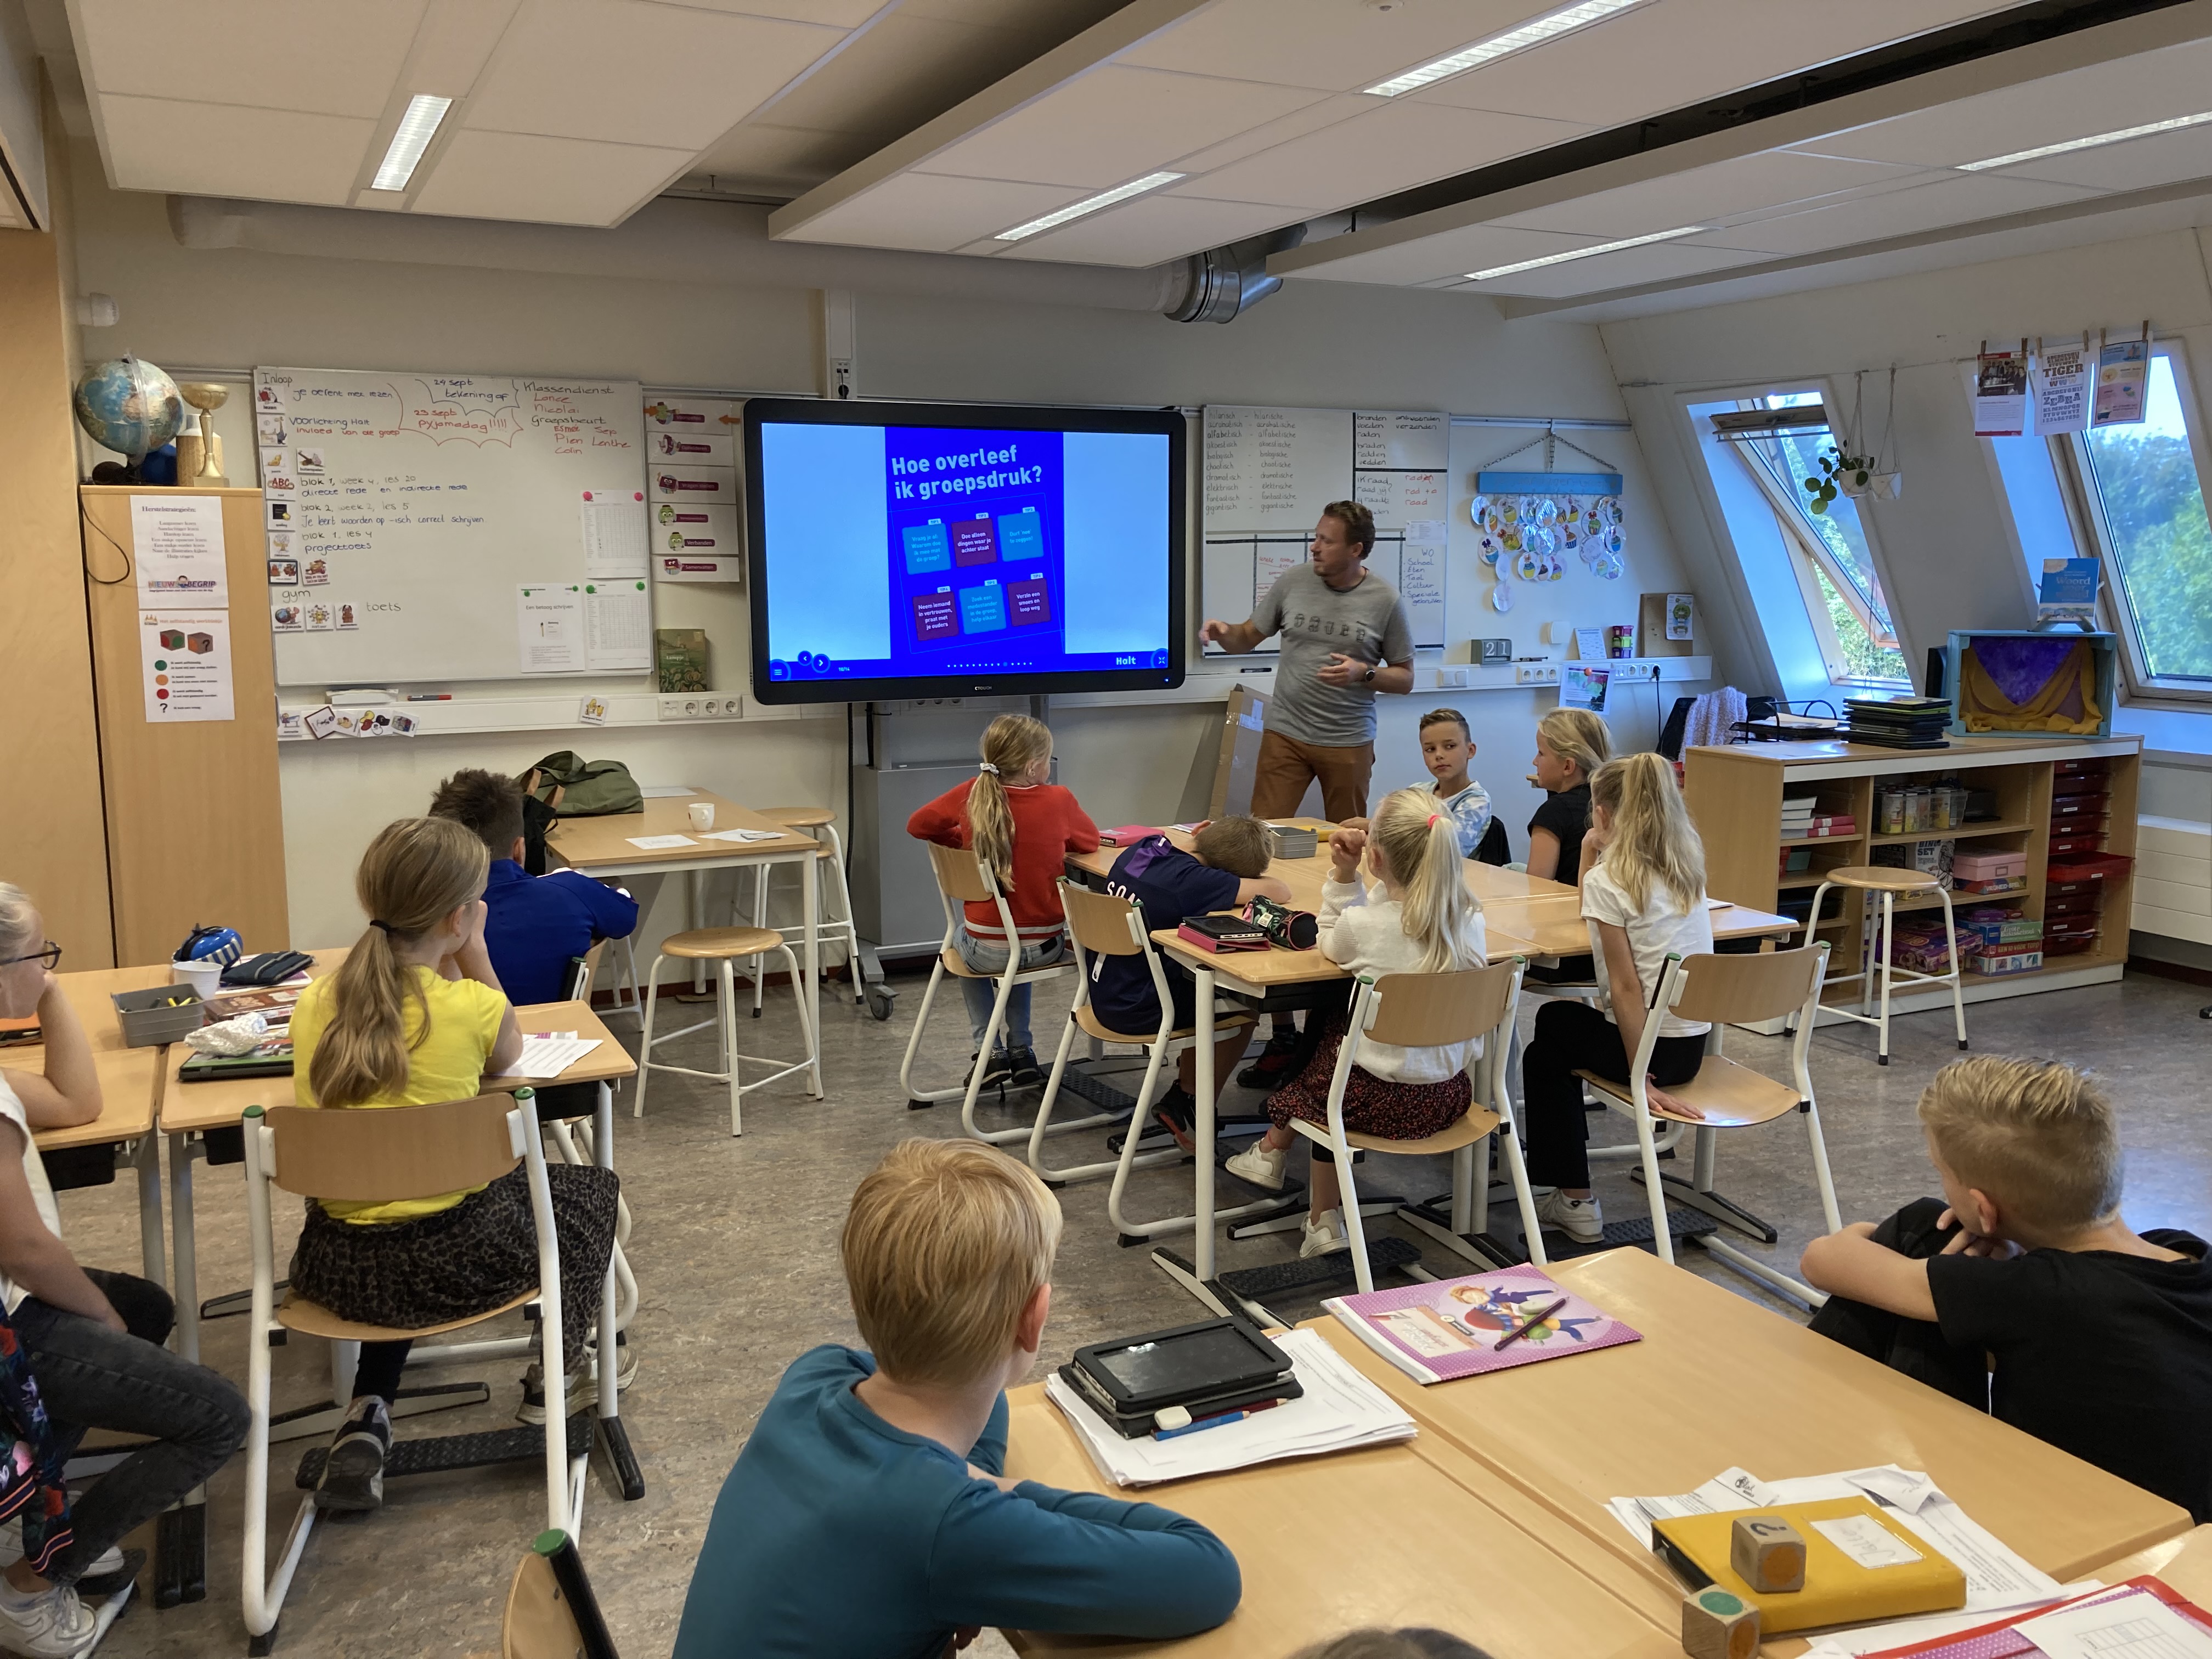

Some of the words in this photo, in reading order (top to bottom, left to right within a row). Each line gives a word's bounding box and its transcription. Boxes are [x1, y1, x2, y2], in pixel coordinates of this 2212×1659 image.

[2042, 363, 2084, 378] TIGER
[263, 372, 293, 384] Inloop
[448, 379, 474, 387] sept
[523, 381, 616, 394] Klassendienst
[311, 389, 343, 398] oefent
[369, 391, 393, 399] lezen
[445, 389, 492, 403] tekening
[534, 393, 573, 404] Lance
[2042, 392, 2081, 407] ZEBRA
[431, 408, 458, 419] sept
[1209, 411, 1236, 420] hilarisch
[1254, 411, 1284, 420] hilarische
[289, 416, 348, 430] Voorlichting
[351, 417, 370, 426] Halt
[379, 429, 400, 438] groep
[594, 426, 617, 437] Sep
[1207, 429, 1243, 439] alfabetisch
[1258, 428, 1296, 438] alfabetische
[555, 433, 584, 445] Pien
[592, 437, 632, 449] Lenthe
[1207, 439, 1238, 449] akoestisch
[1259, 440, 1292, 448] akoestische
[555, 447, 583, 455] Colin
[1207, 450, 1234, 463] biologisch
[1260, 450, 1288, 460] biologische
[891, 456, 930, 476] Hoe
[935, 444, 1017, 471] overleef
[1206, 461, 1234, 471] chaotisch
[272, 477, 290, 487] ABC
[300, 476, 325, 487] blok
[339, 476, 368, 484] week
[385, 476, 399, 484] les
[1206, 472, 1242, 481] dramatisch
[894, 481, 915, 499] ik
[919, 465, 1042, 500] groepsdruk?
[1206, 483, 1239, 492] elektrisch
[1262, 482, 1293, 490] elektrische
[302, 487, 340, 497] directe
[399, 484, 442, 493] indirecte
[1206, 494, 1240, 503] fantastisch
[1261, 492, 1297, 500] fantastische
[300, 503, 322, 512] blok
[337, 503, 364, 511] week
[382, 500, 397, 511] les
[402, 502, 410, 510] 5
[1206, 503, 1238, 516] gigantisch
[1261, 501, 1294, 514] gigantische
[301, 516, 314, 527] Je
[318, 515, 336, 526] leert
[341, 516, 374, 526] woorden
[375, 517, 385, 527] op
[418, 514, 445, 524] correct
[302, 530, 325, 540] blok
[346, 530, 362, 538] les
[304, 541, 373, 556] projecttoets
[1421, 548, 1435, 557] WO
[1407, 558, 1435, 566] School
[2056, 577, 2091, 585] Woord
[281, 588, 312, 603] gym
[1407, 590, 1441, 599] Speciale
[365, 601, 402, 612] toets
[1412, 597, 1443, 606] gebruiken
[1115, 656, 1137, 665] Halt
[160, 703, 168, 713] ?
[1917, 848, 1934, 856] SET
[1750, 1522, 1787, 1537] ?
